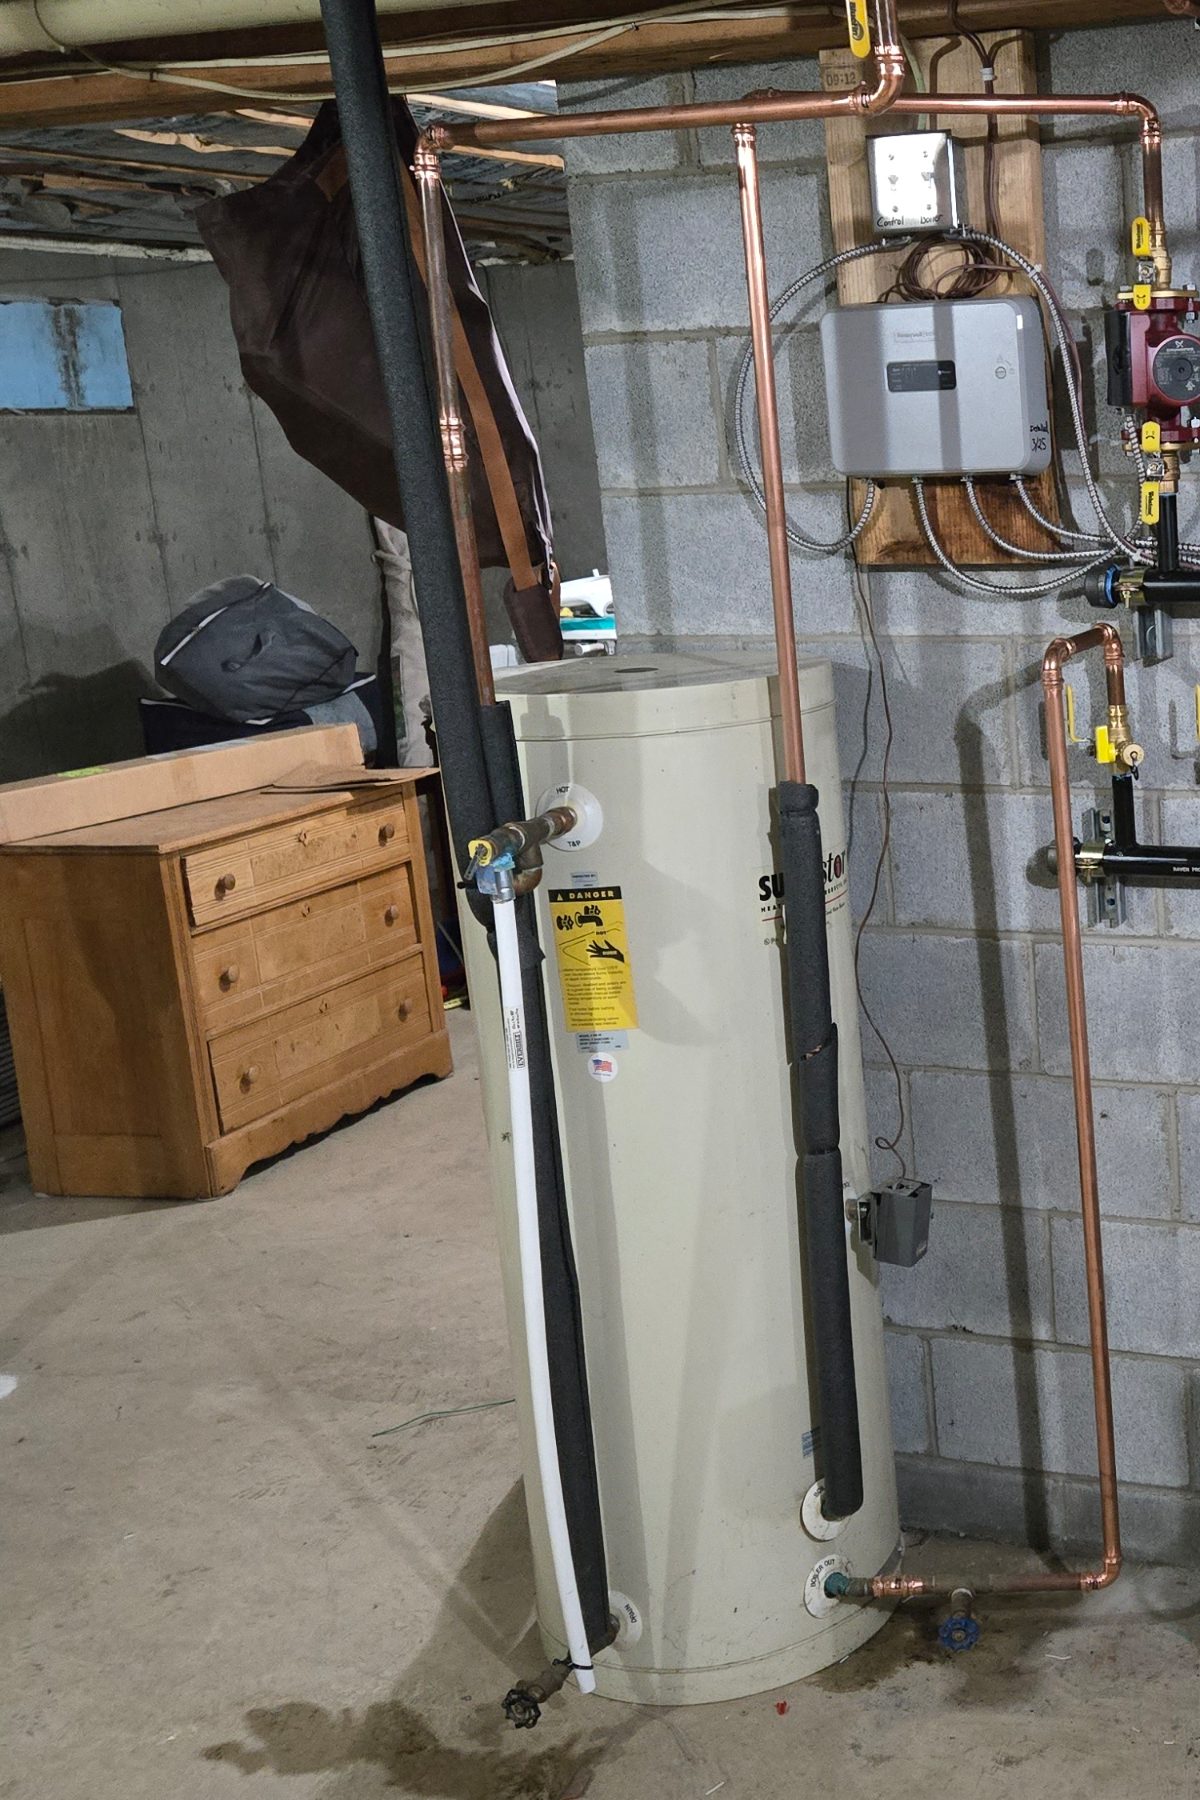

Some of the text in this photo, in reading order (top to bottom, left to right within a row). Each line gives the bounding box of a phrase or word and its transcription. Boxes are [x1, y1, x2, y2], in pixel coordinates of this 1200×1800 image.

[876, 214, 905, 226] Control
[556, 786, 570, 795] HOT
[569, 890, 615, 900] DANGER
[823, 1558, 836, 1567] OUT
[624, 1603, 638, 1624] DRAIN
